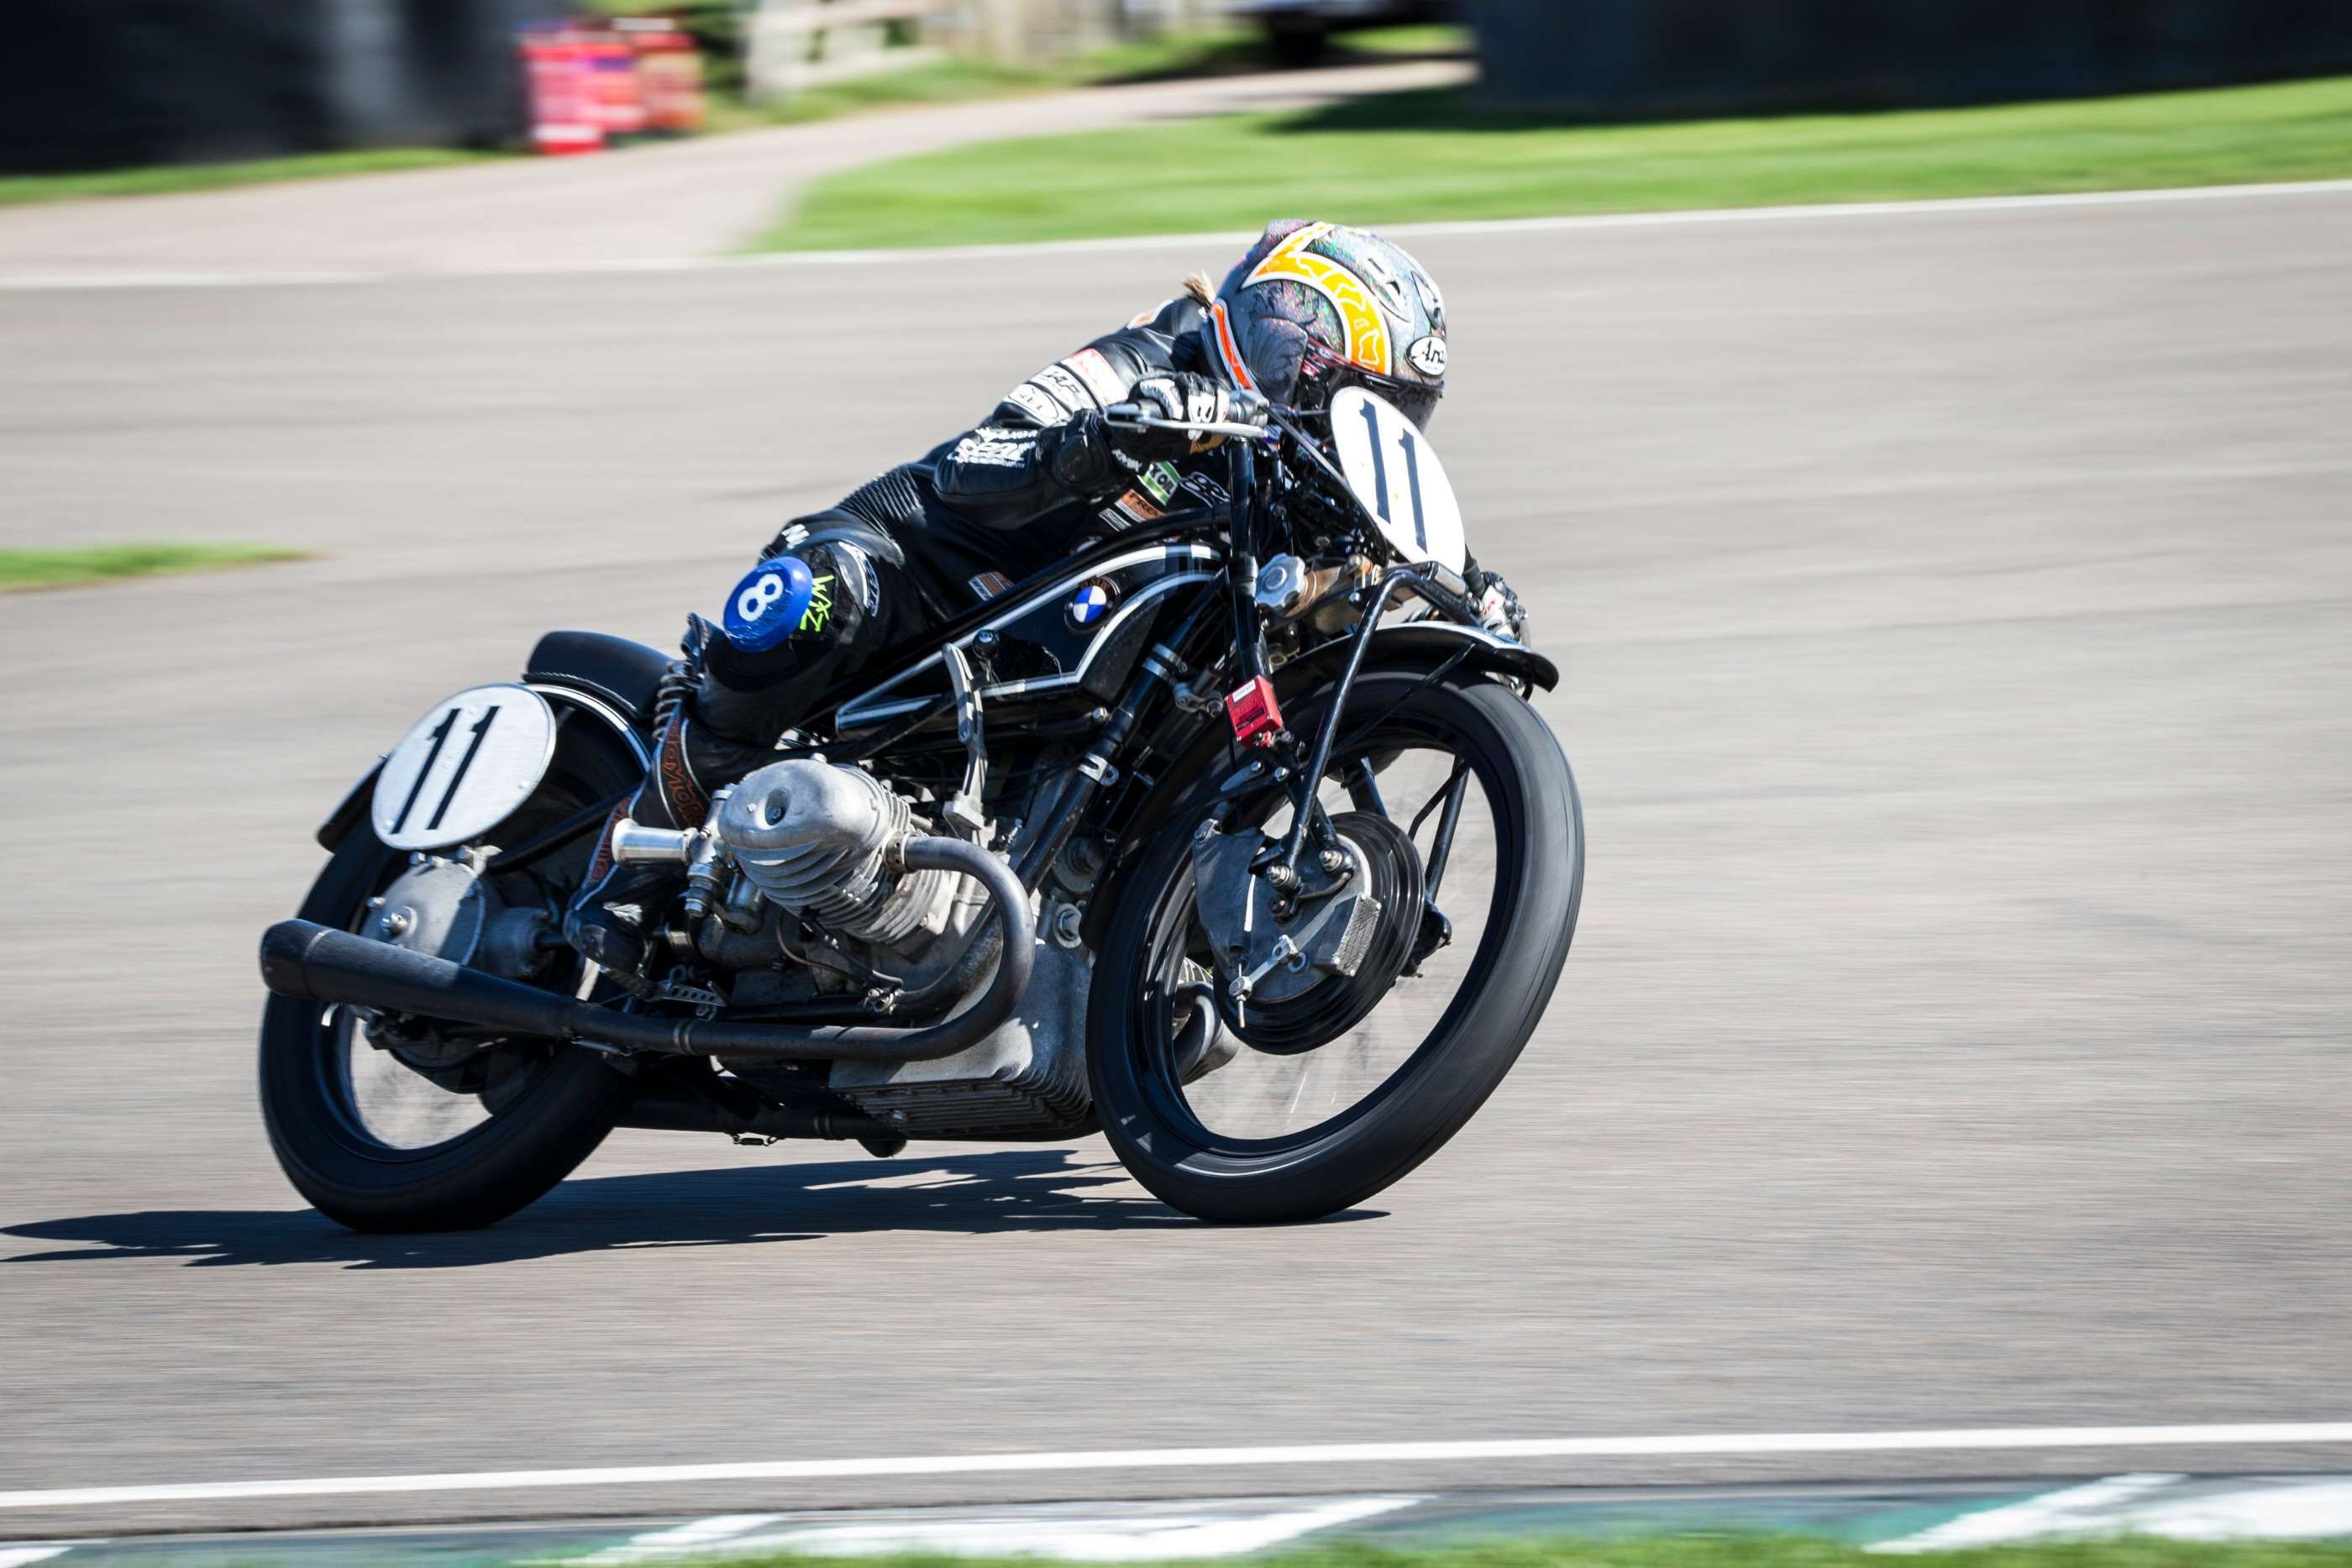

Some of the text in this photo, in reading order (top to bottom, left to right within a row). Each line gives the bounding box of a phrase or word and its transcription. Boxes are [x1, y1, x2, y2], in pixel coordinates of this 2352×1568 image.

[1359, 398, 1427, 554] 11
[738, 573, 784, 621] 8
[388, 705, 501, 836] 11
